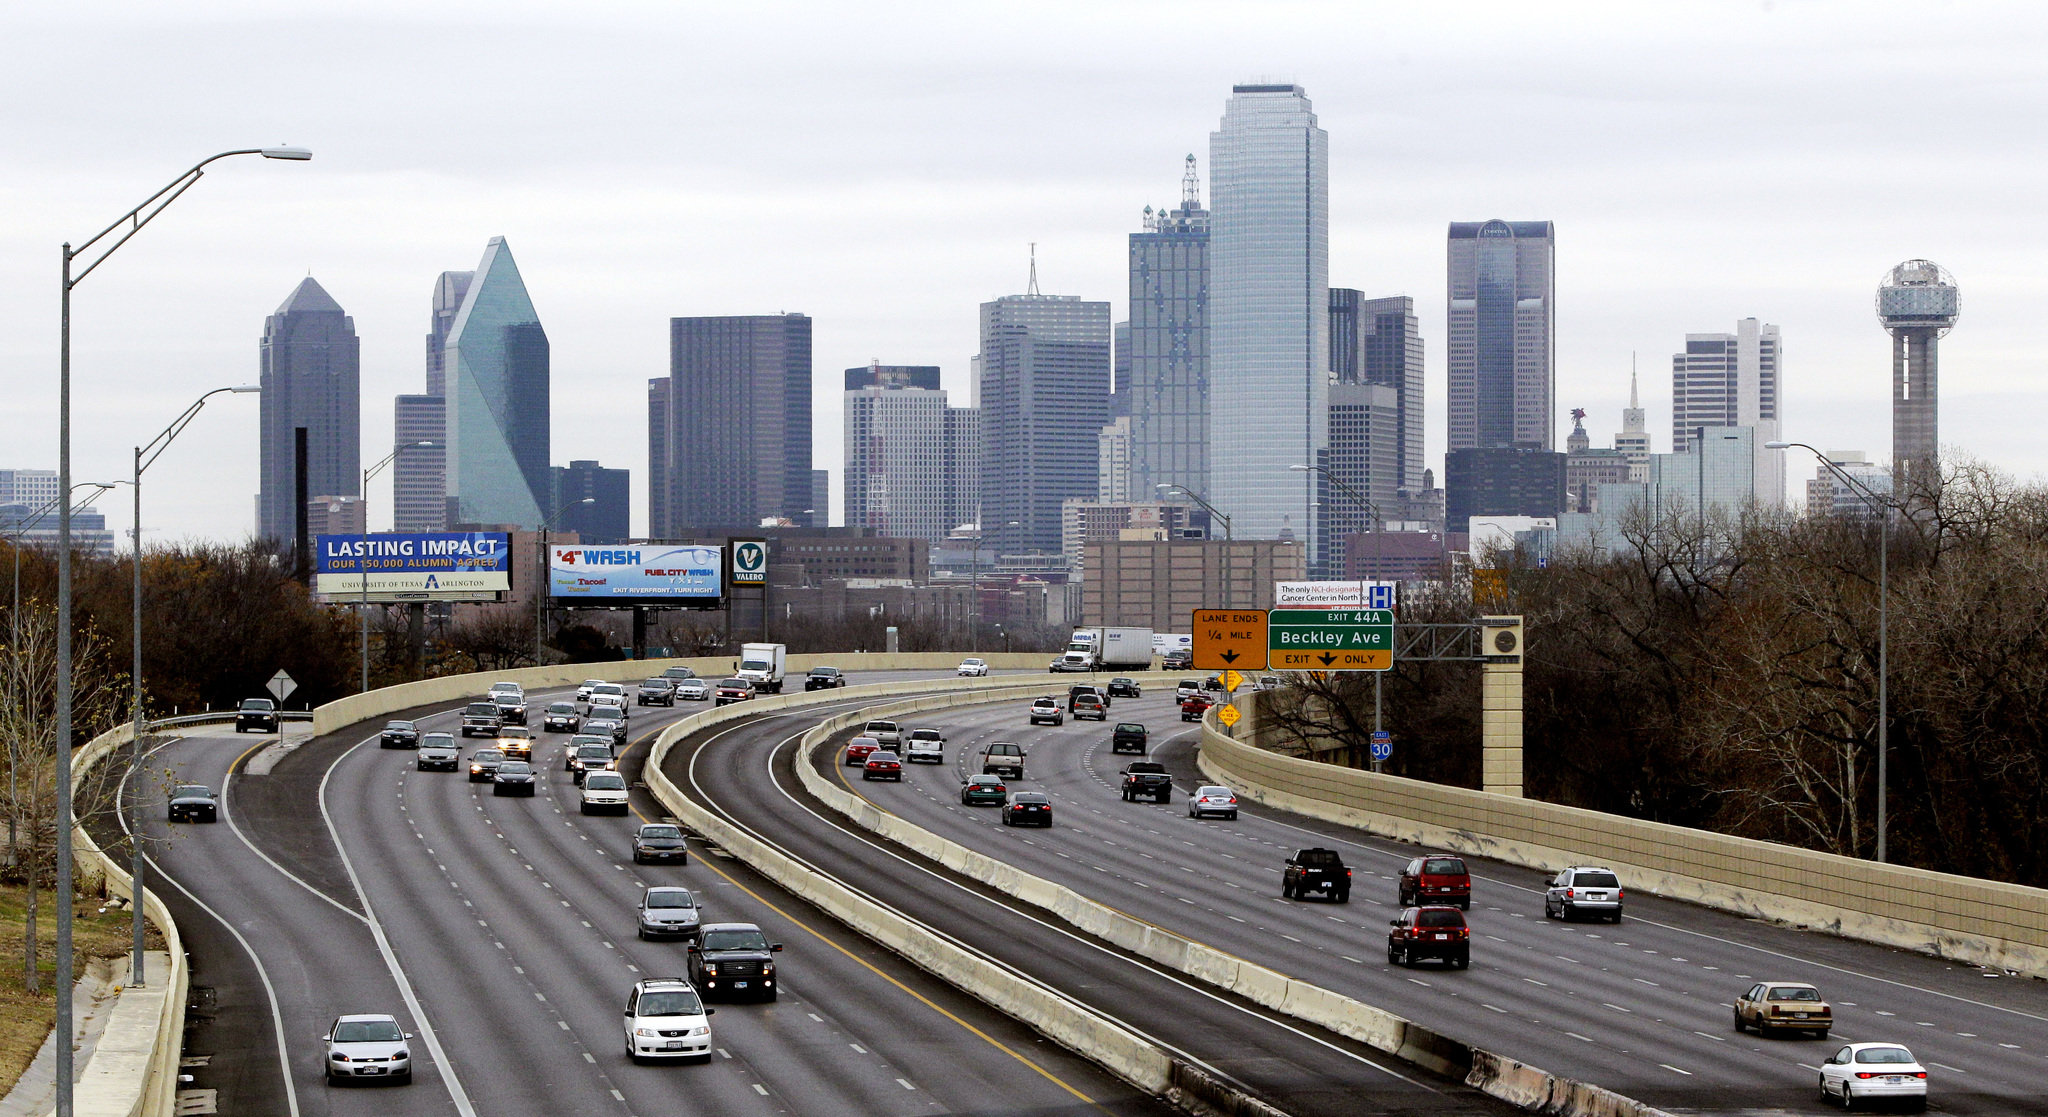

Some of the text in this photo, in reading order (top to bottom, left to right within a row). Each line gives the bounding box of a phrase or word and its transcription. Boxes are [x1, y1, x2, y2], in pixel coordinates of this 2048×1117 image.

[328, 539, 498, 557] LASTING IMPACT
[583, 550, 641, 565] WASH
[328, 558, 499, 570] (OUR 150,000 ALUMNI AGREE)
[578, 578, 607, 586] Tacos!
[735, 573, 764, 581] VALERO
[440, 580, 485, 588] ARLINGTON
[1281, 585, 1295, 593] The
[1295, 585, 1311, 595] only
[1281, 594, 1305, 602] Cancer
[1306, 594, 1329, 602] Center
[1372, 587, 1389, 608] H
[1202, 614, 1258, 623] LANE ENDS
[1327, 611, 1381, 623] EXIT 44A
[1230, 631, 1253, 640] MILE
[1281, 631, 1381, 647] Beckley Ave
[1285, 654, 1376, 664] EXIT ONLY
[1373, 744, 1390, 756] 30
